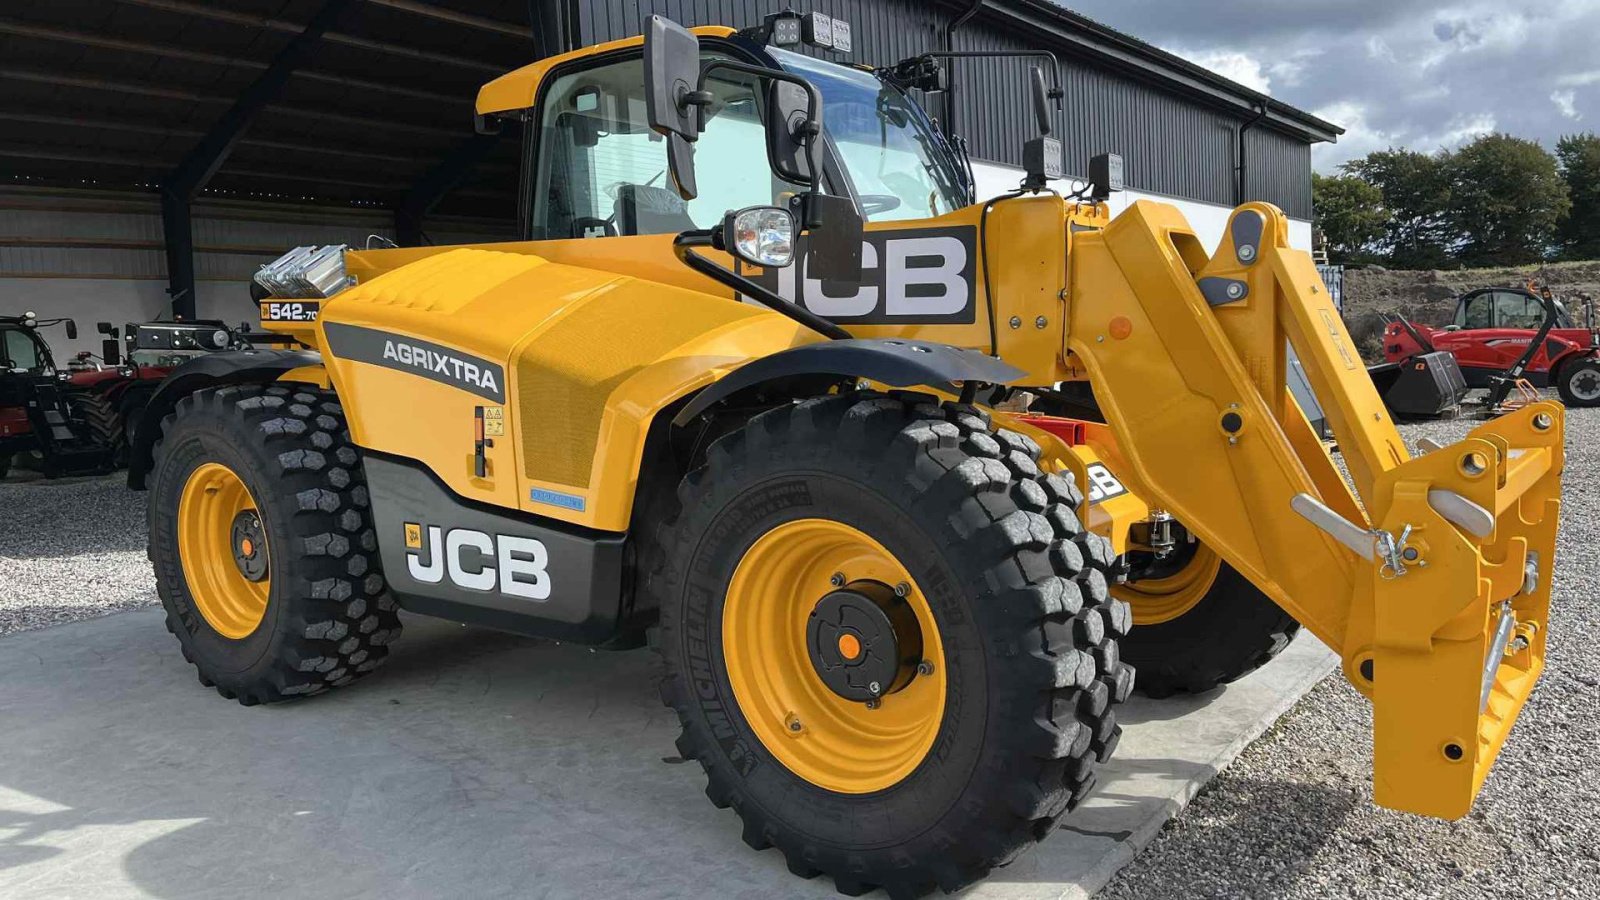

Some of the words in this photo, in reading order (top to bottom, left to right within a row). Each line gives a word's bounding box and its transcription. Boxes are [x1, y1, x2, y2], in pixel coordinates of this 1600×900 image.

[383, 340, 499, 393] AGRIXTRA
[407, 526, 551, 600] JCB
[687, 584, 735, 740] MICHELIN
